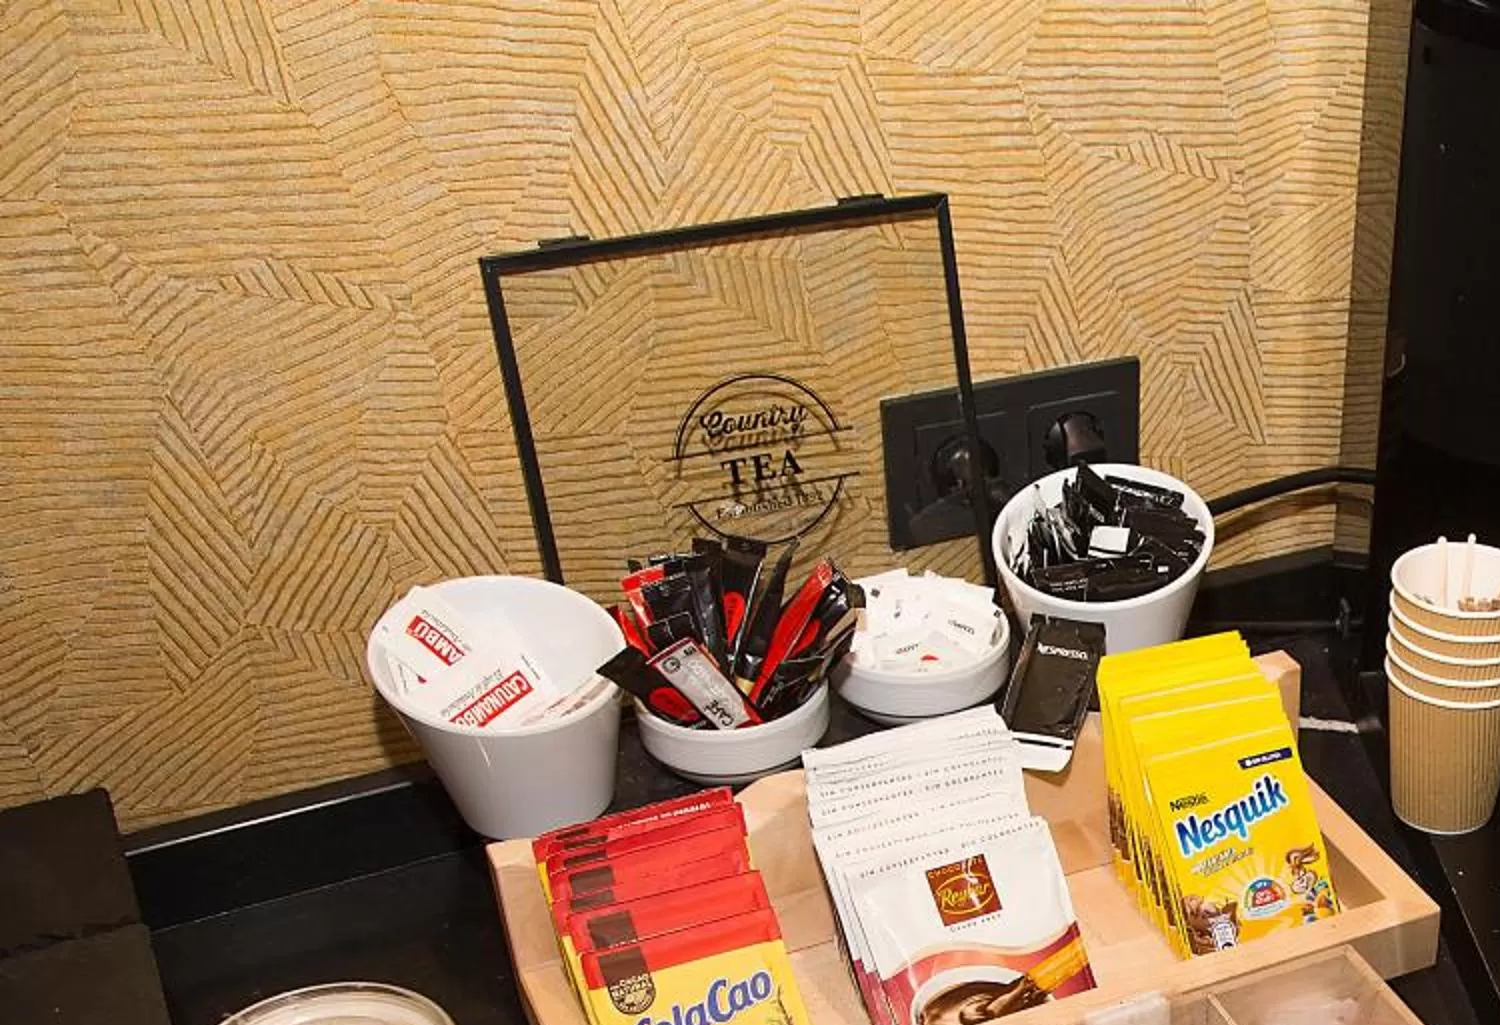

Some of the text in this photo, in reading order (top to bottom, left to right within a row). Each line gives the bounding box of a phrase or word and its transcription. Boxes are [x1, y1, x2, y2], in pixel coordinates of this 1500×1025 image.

[700, 404, 808, 438] Country
[720, 449, 804, 486] TEA
[1037, 641, 1089, 661] NESPRESSO
[1176, 776, 1287, 855] Nesquik
